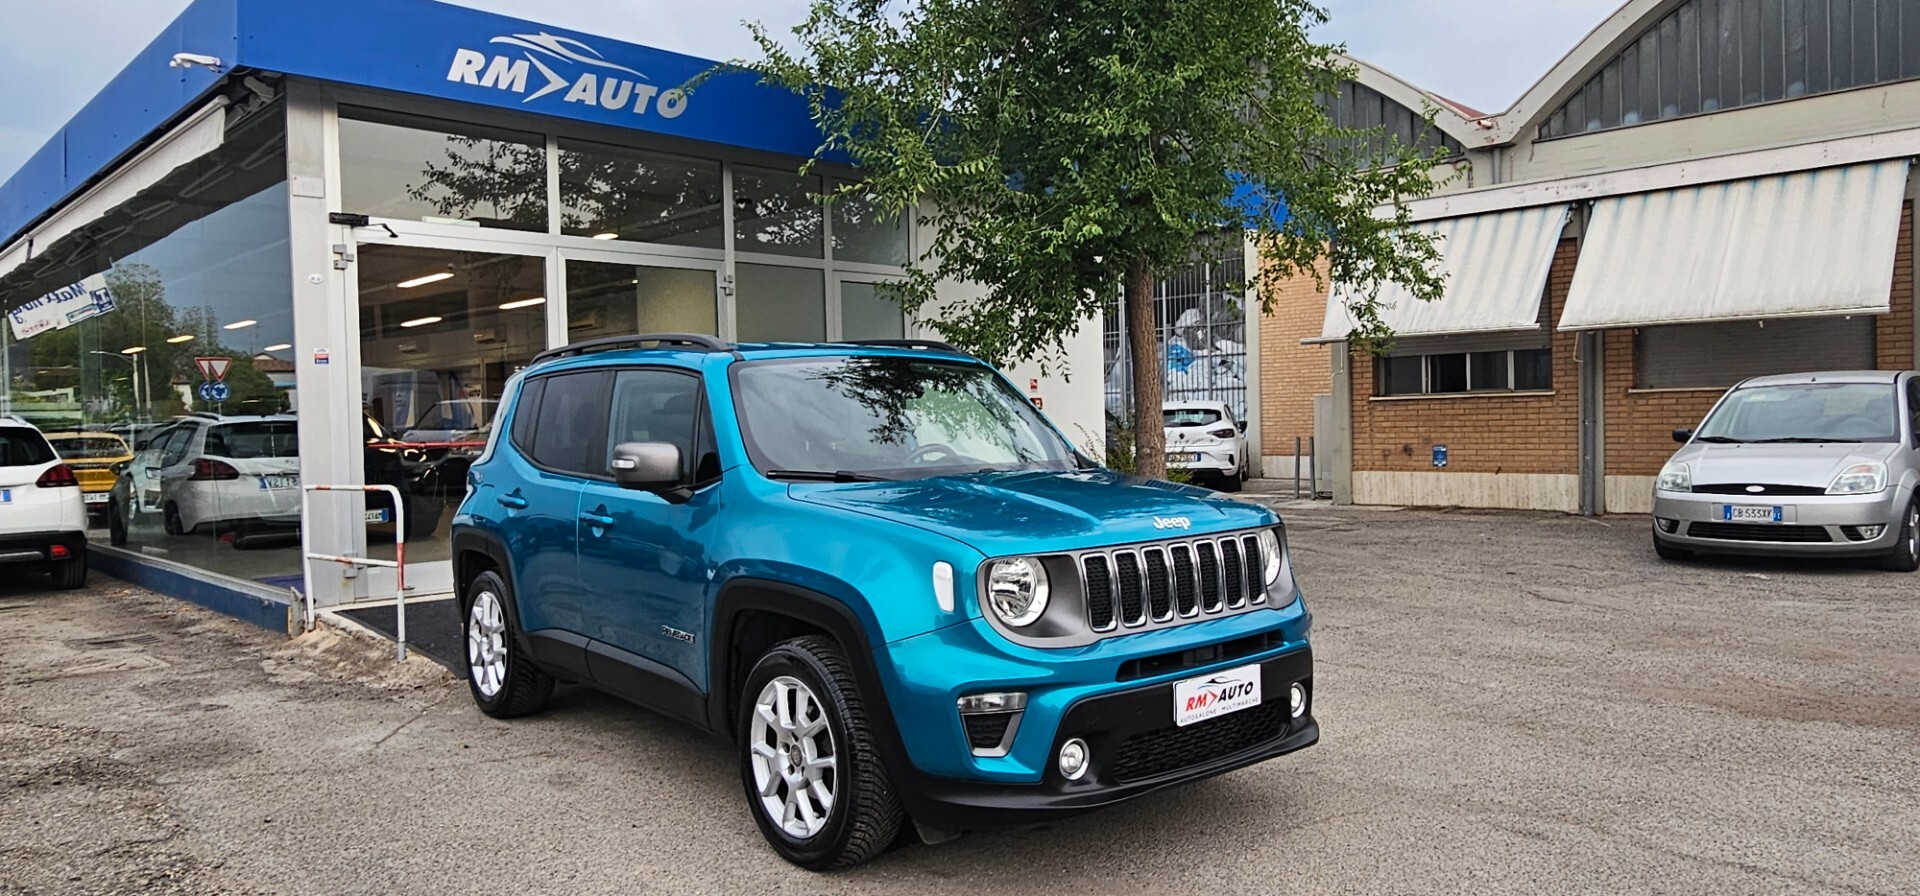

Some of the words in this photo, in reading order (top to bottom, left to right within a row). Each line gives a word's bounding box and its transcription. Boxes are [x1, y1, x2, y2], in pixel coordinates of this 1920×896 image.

[447, 48, 530, 93] RM
[563, 73, 688, 119] AUTO
[1153, 516, 1191, 530] Jeep
[1186, 694, 1208, 711] RM
[1217, 681, 1254, 703] AUTO
[1180, 709, 1217, 724] AUTOSALONE
[1222, 697, 1259, 711] MULTIMARCHE
